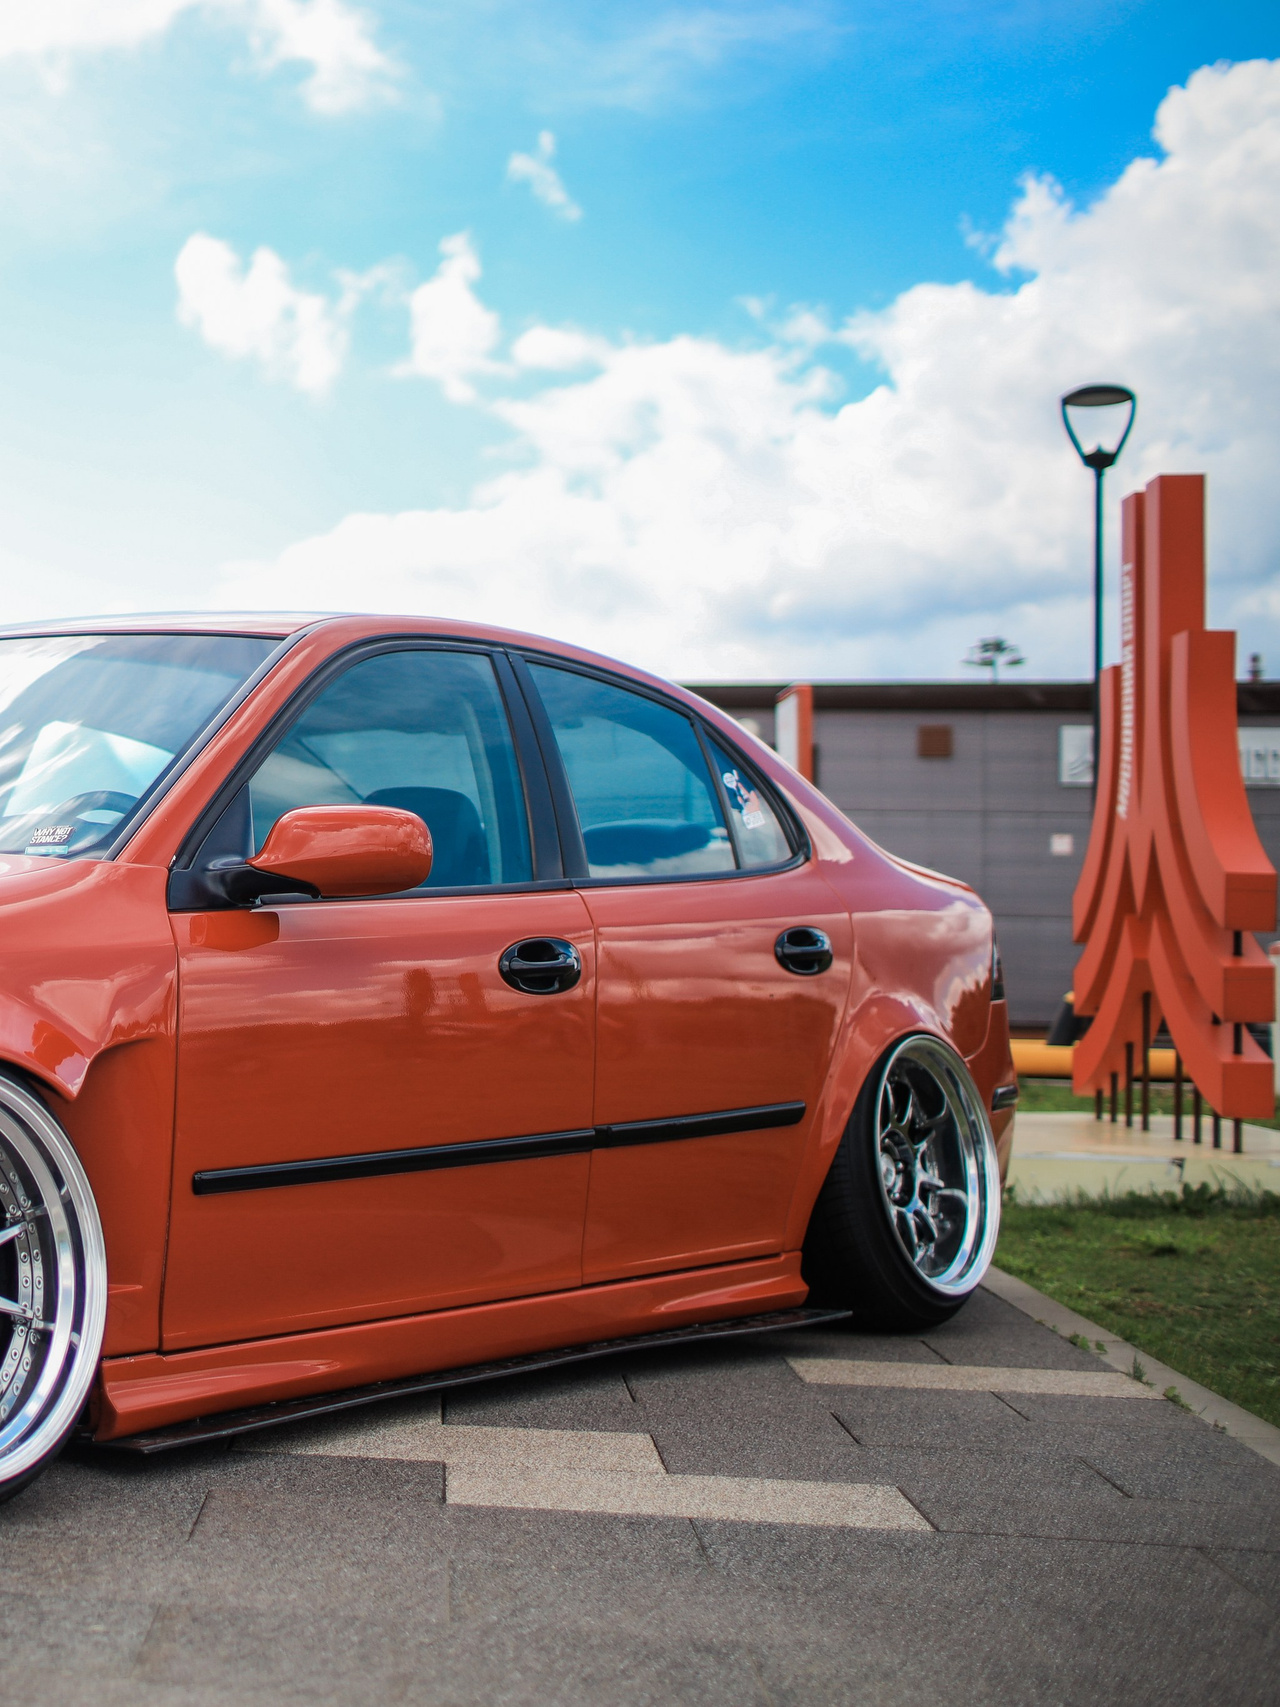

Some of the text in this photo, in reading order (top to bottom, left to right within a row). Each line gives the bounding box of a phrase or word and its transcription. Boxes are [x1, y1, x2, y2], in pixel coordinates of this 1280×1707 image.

[34, 827, 74, 836] WHY NOT
[30, 835, 68, 843] STANCE?
